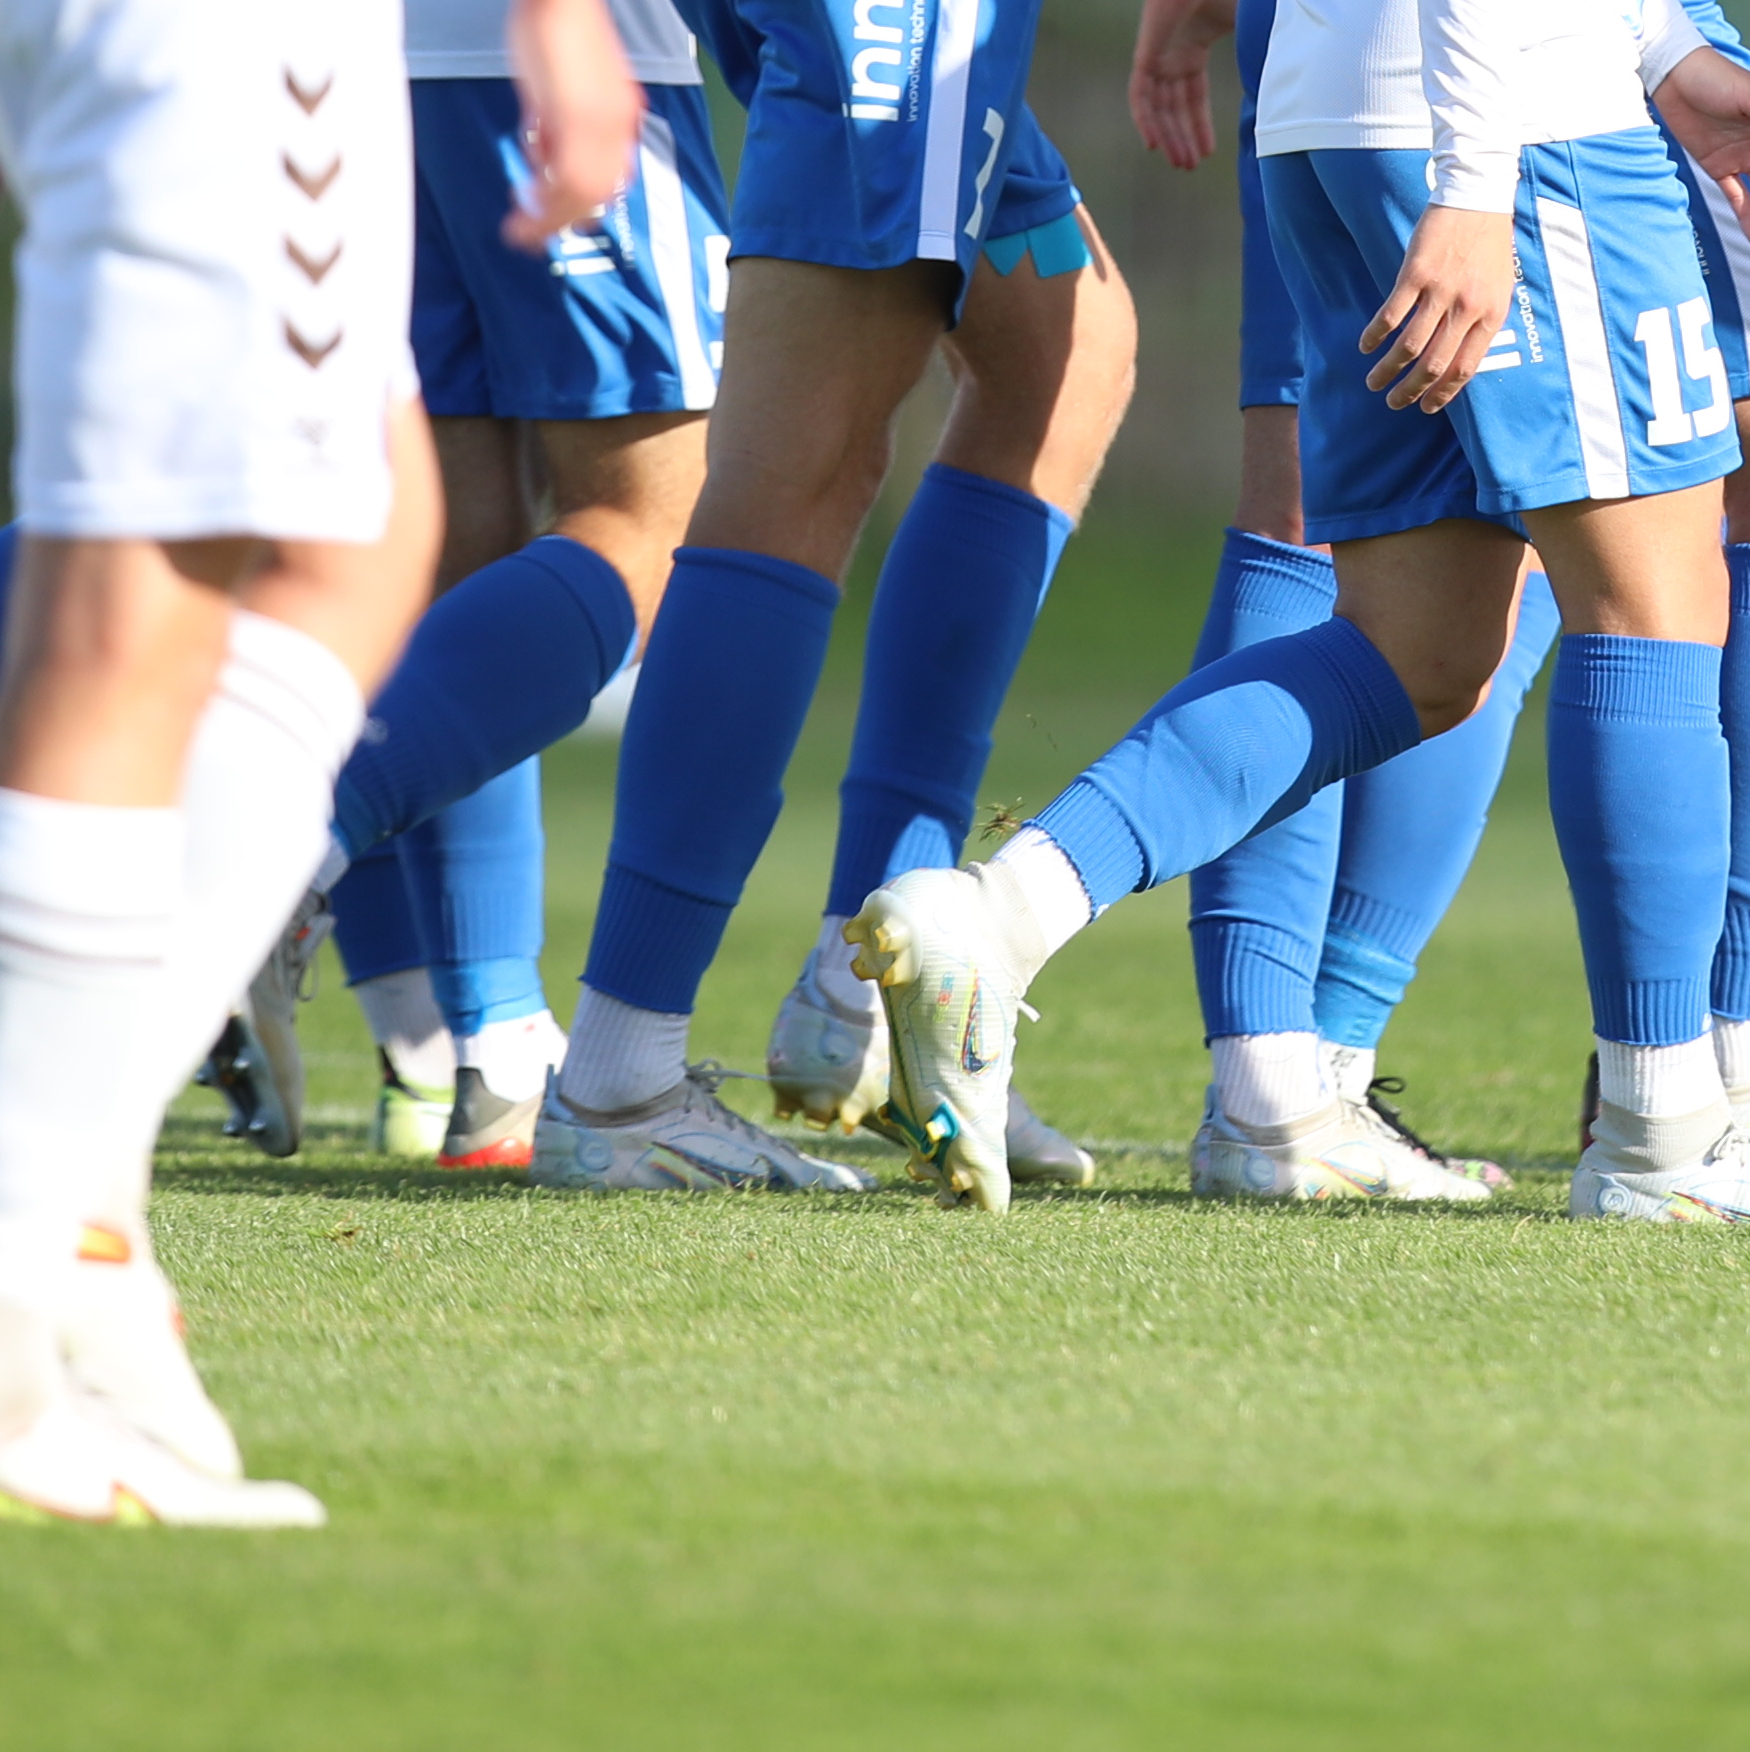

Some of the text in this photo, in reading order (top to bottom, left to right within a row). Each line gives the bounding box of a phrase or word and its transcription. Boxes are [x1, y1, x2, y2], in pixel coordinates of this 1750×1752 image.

[906, 46, 923, 122] innovation
[1516, 285, 1544, 364] innovation
[1633, 295, 1733, 447] 15
